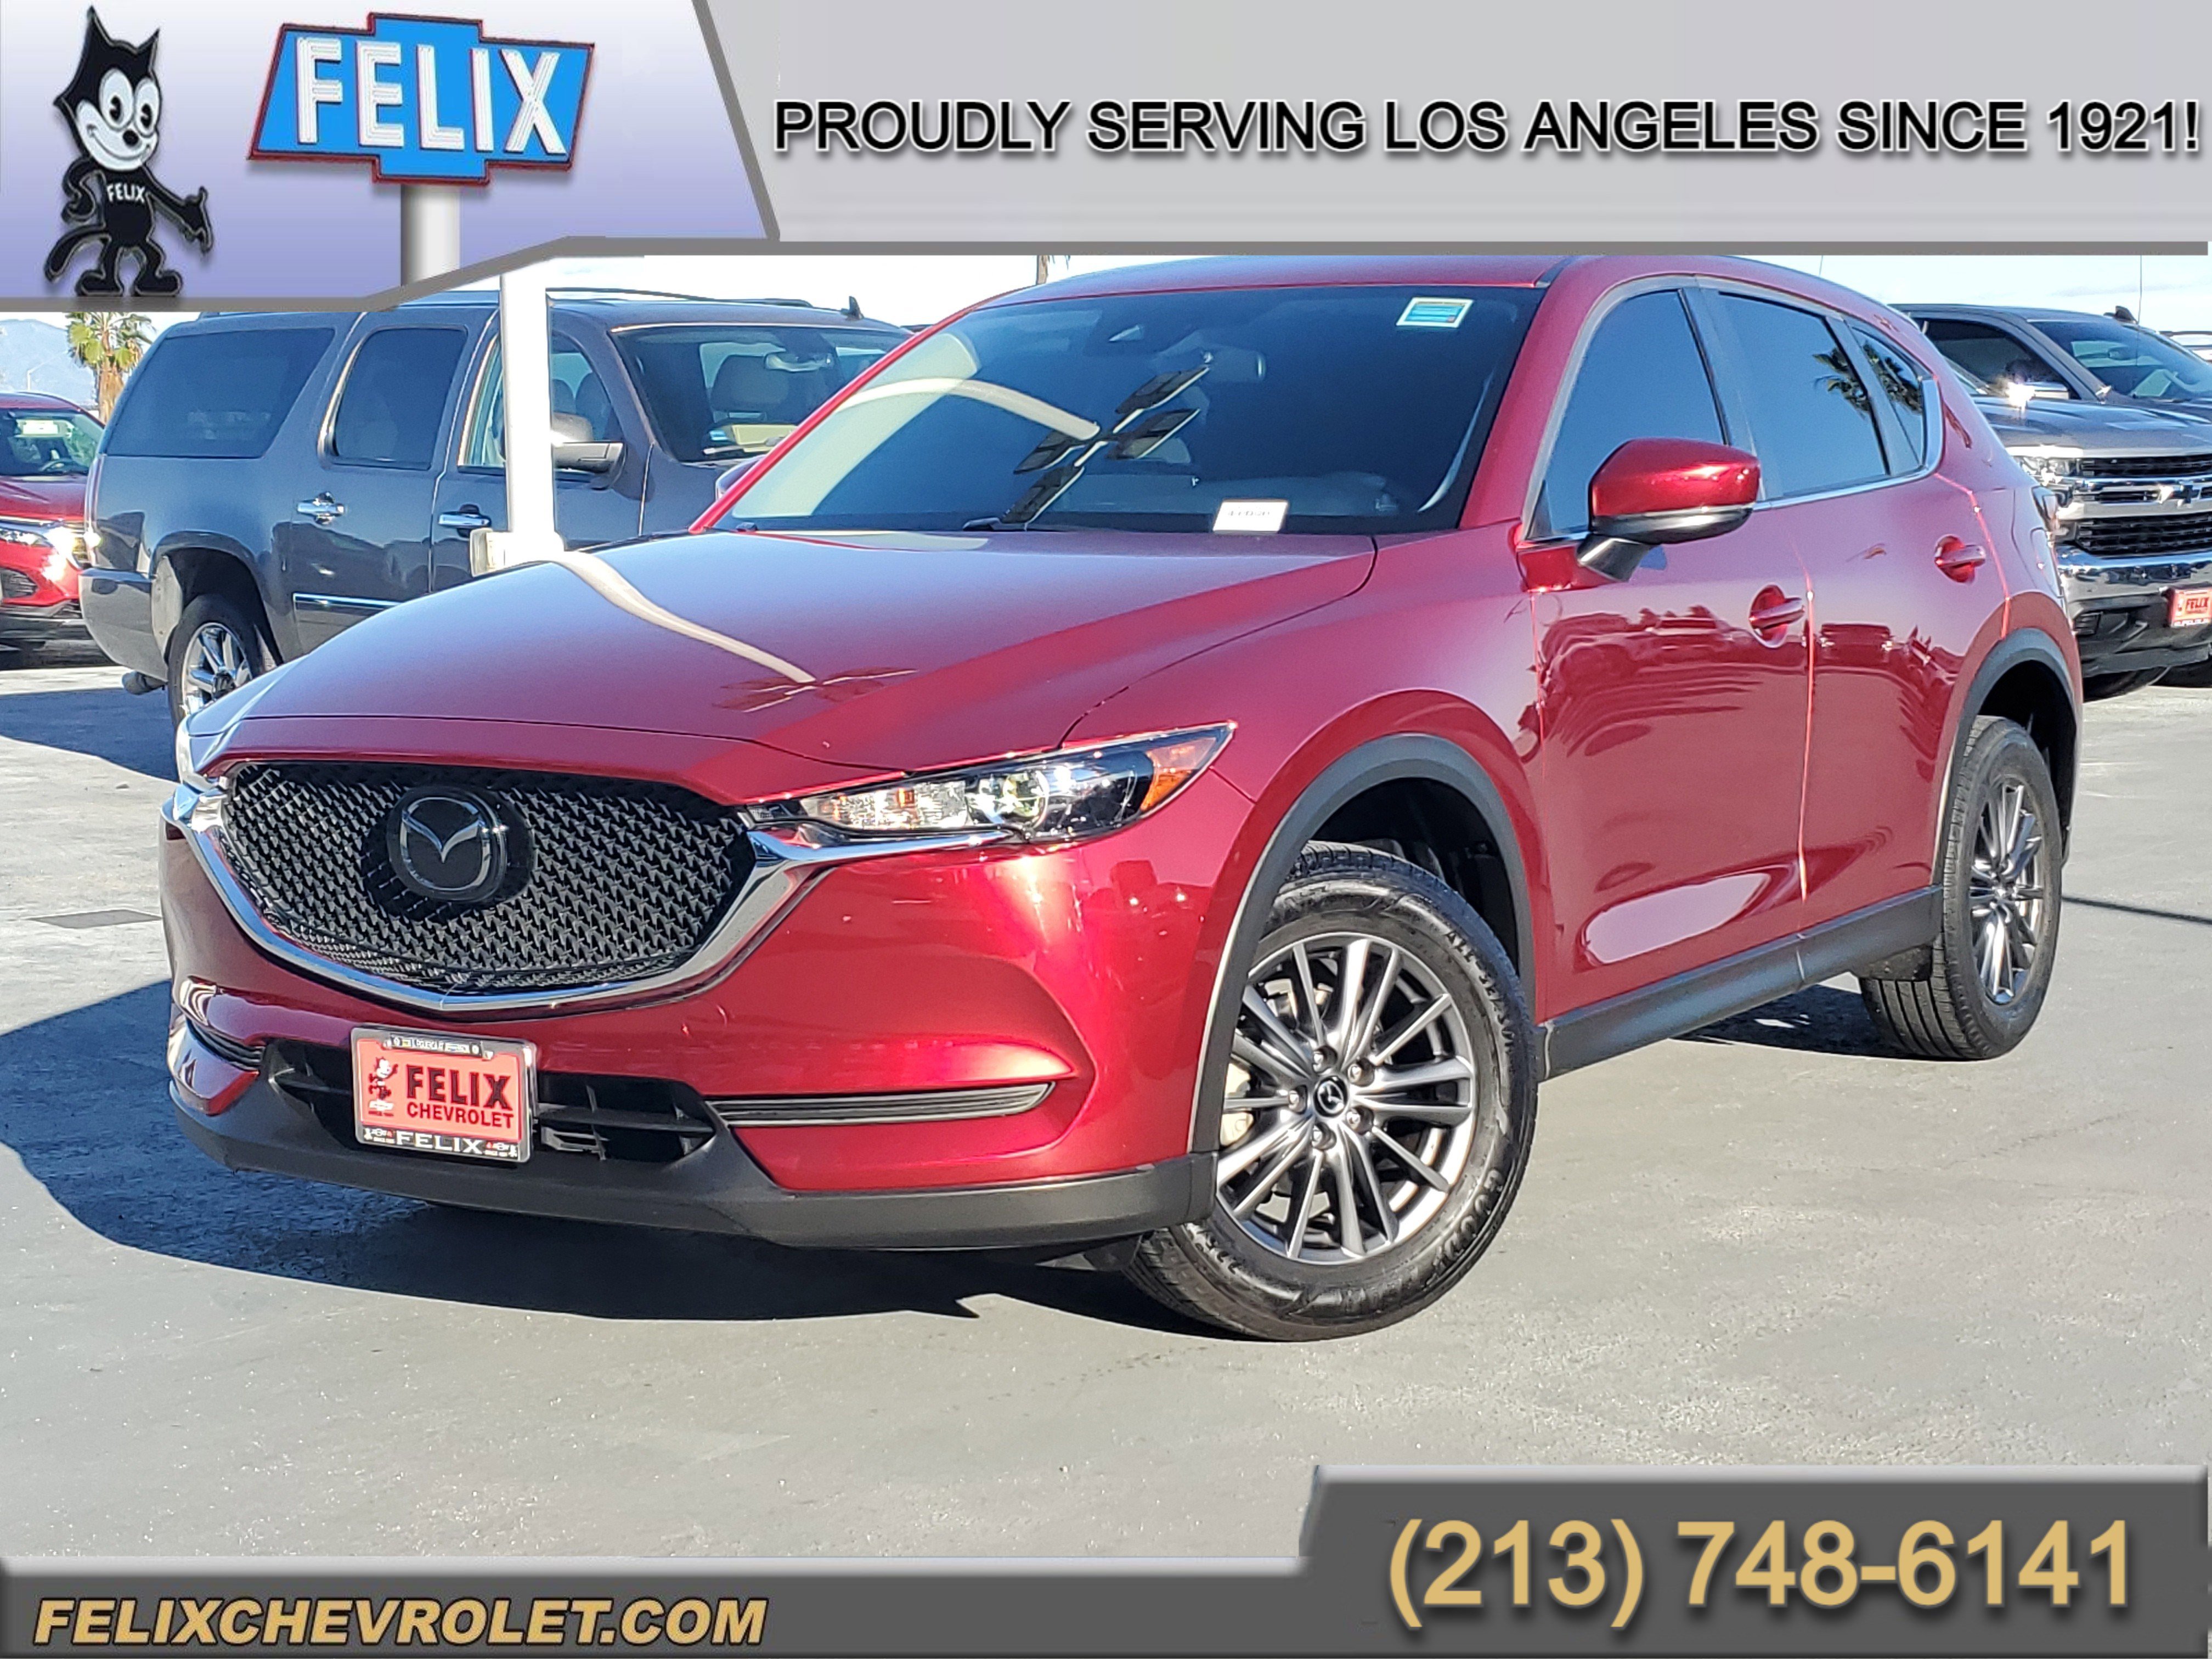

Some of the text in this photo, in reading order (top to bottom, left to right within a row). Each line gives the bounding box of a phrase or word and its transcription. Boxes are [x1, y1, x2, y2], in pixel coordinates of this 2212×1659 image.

[407, 1064, 513, 1111] FELIX
[407, 1102, 515, 1128] CHEVROLET
[396, 1130, 484, 1155] FELIX
